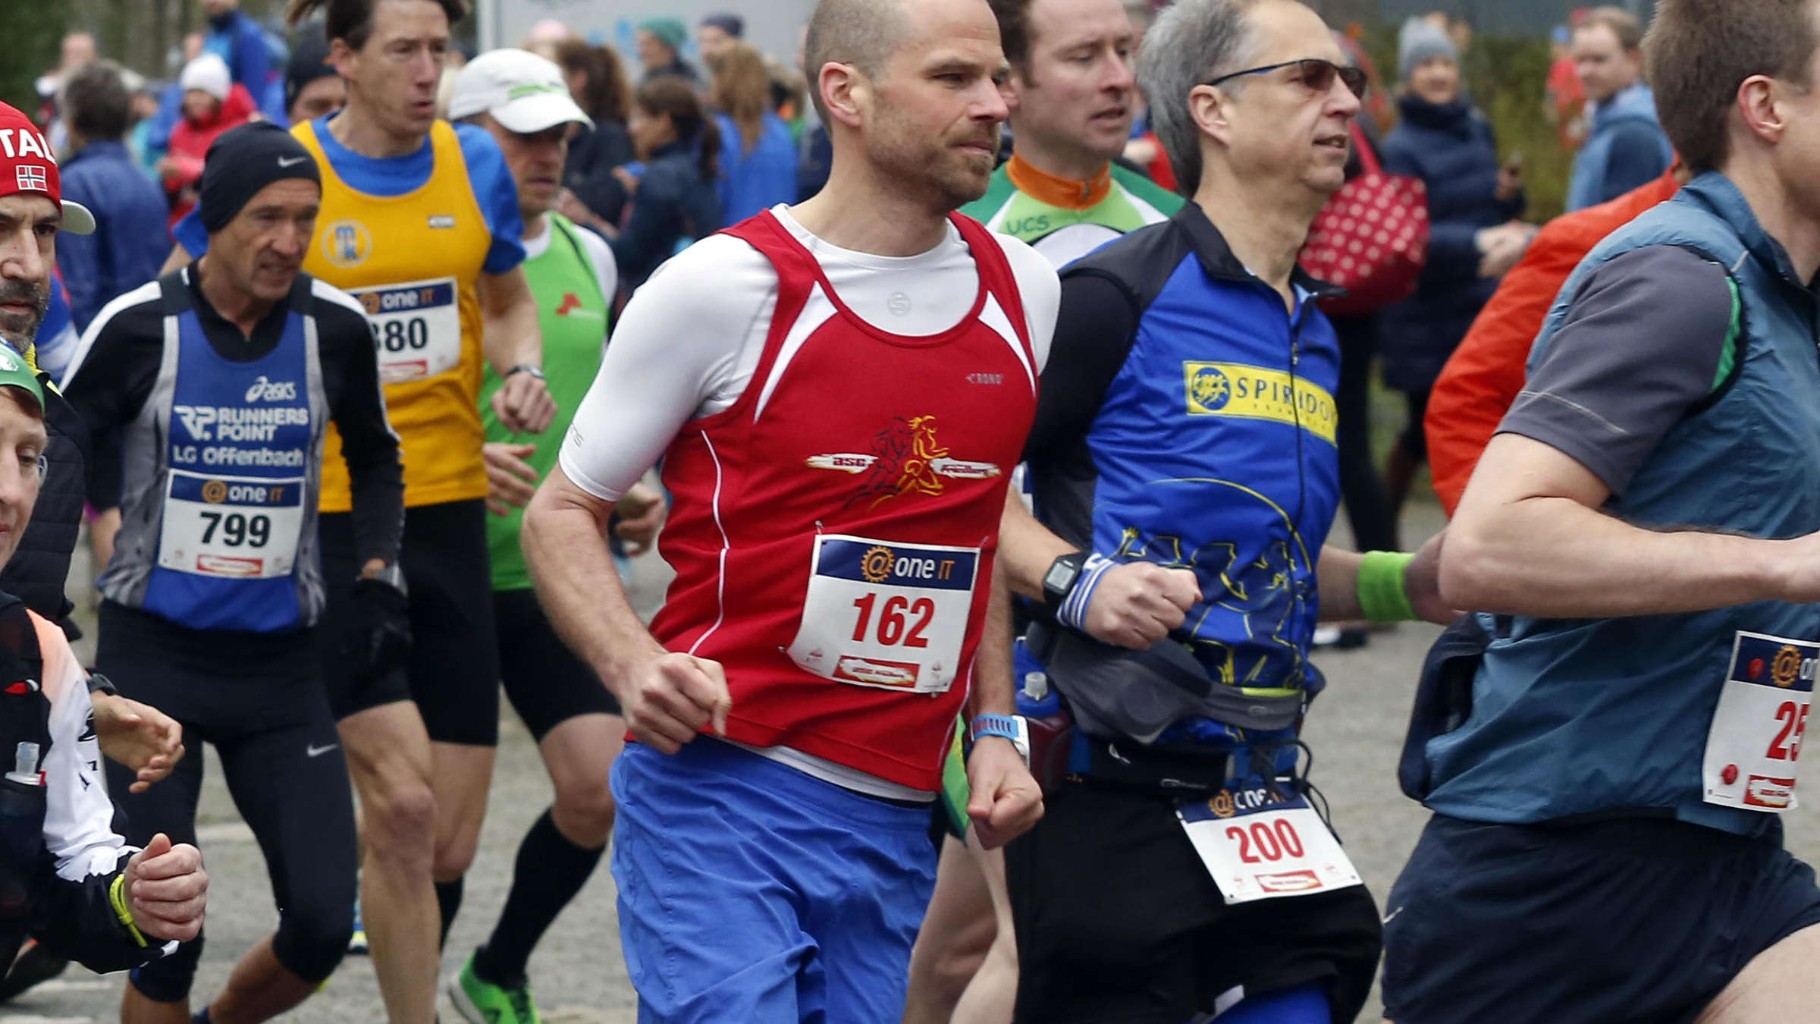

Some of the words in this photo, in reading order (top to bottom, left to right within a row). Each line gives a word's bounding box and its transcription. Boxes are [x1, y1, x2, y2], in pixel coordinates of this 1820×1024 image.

[1006, 215, 1050, 235] UCS
[217, 407, 309, 426] RUNNERS
[216, 424, 278, 441] POINT
[173, 446, 198, 464] LG
[202, 447, 305, 467] Offenbach
[200, 511, 271, 548] 799
[937, 559, 956, 580] IT
[851, 592, 935, 648] 162
[1225, 818, 1305, 863] 200
